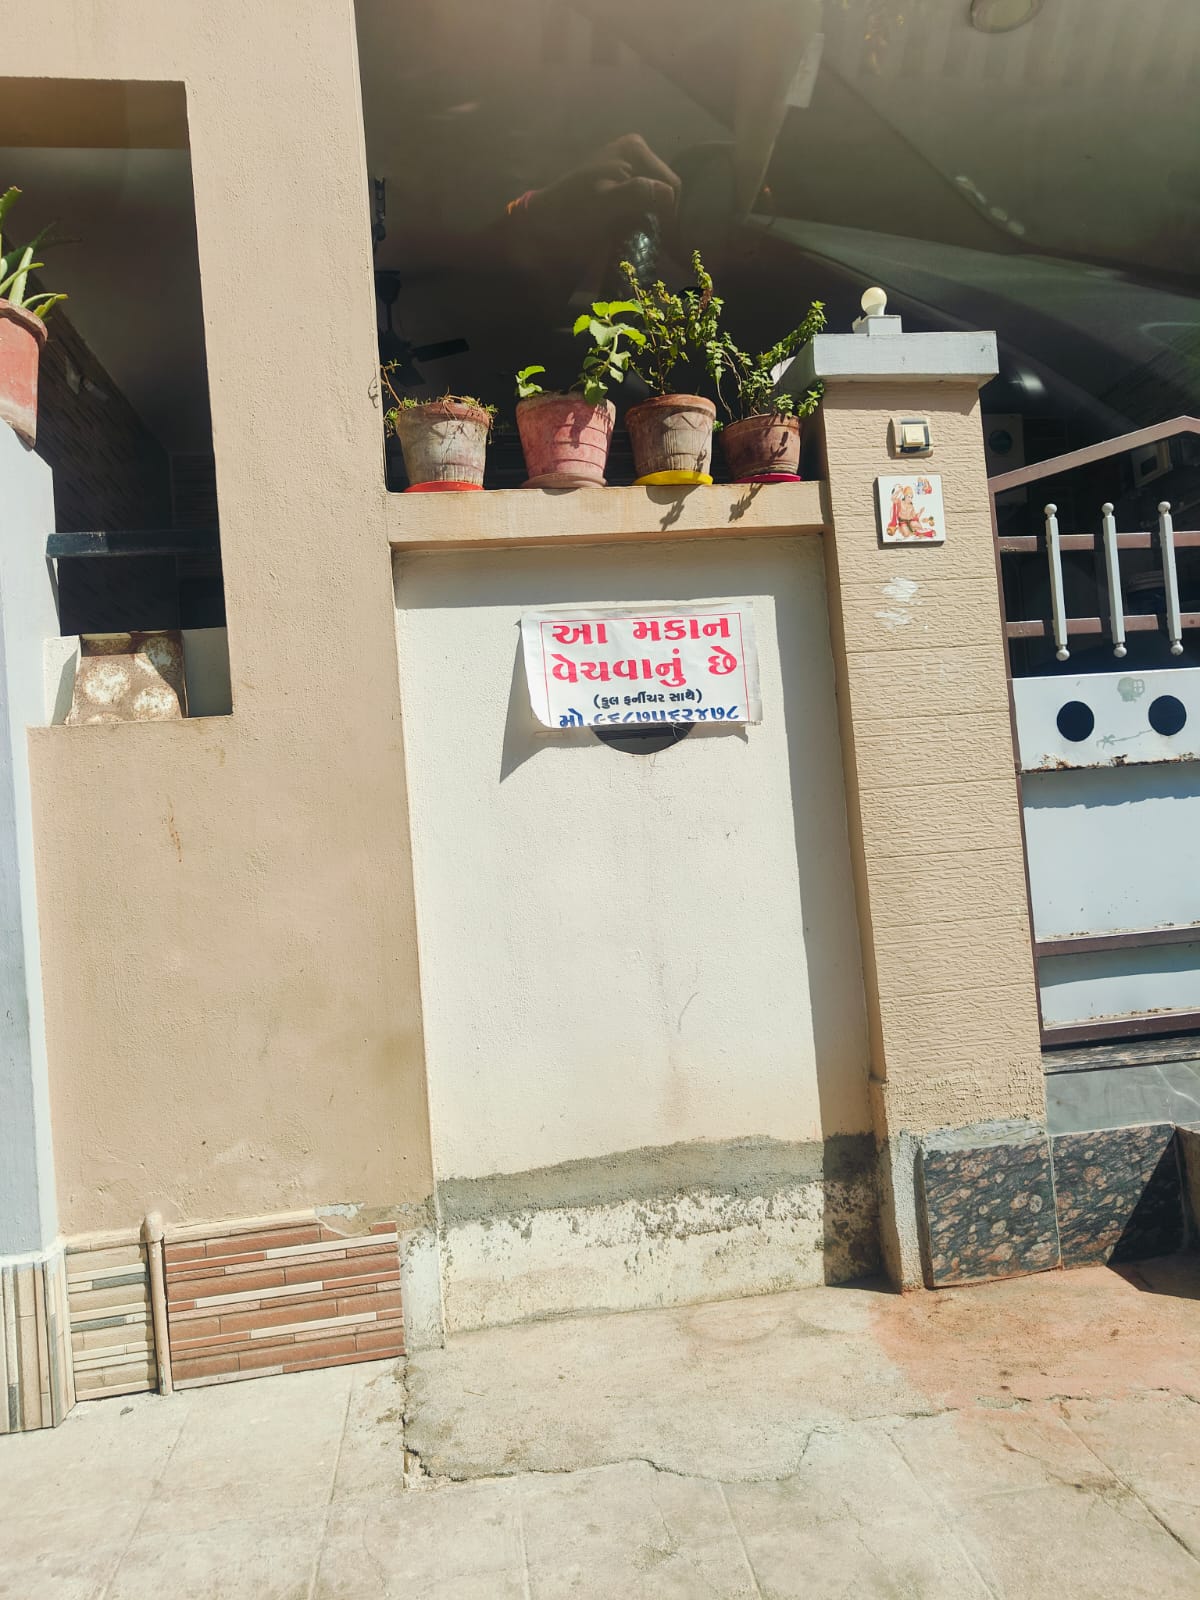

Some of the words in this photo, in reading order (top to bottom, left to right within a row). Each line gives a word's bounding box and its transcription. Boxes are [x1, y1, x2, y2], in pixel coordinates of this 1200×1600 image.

[551, 622, 608, 645] આ
[632, 616, 731, 642] મકાન
[551, 647, 687, 687] વેચવાનું
[707, 645, 738, 675] છે
[669, 688, 702, 703] સાથે)
